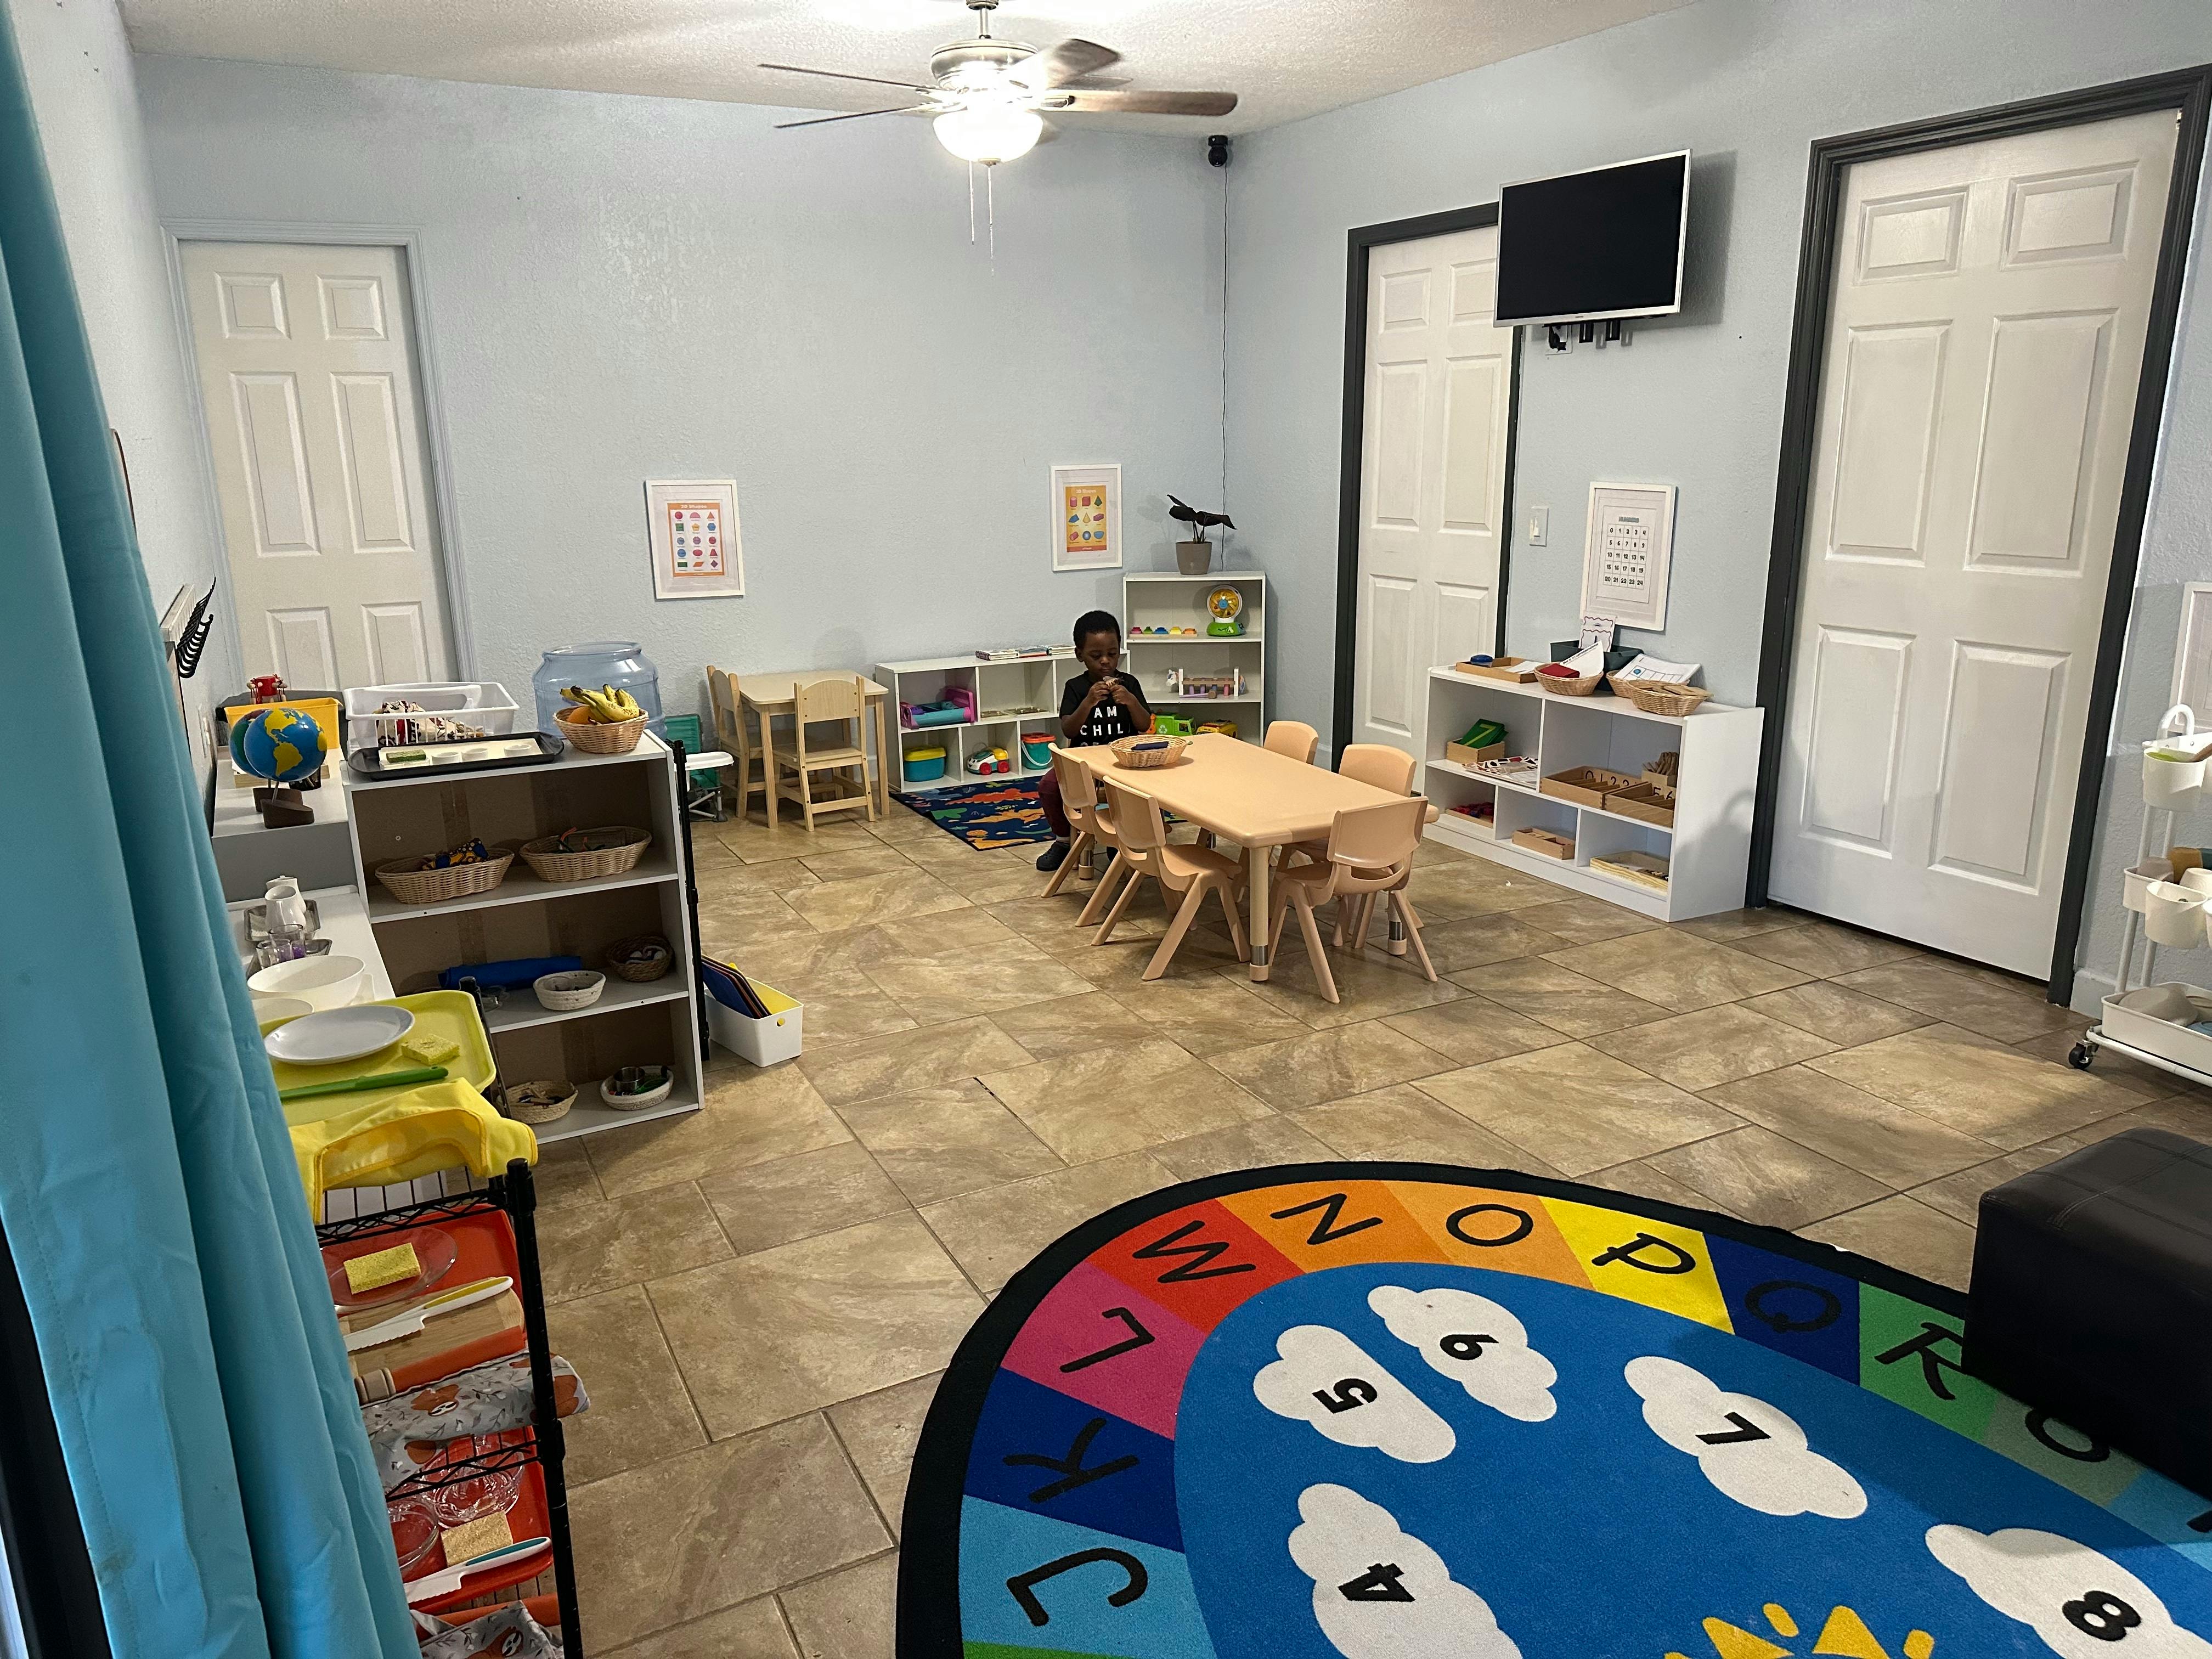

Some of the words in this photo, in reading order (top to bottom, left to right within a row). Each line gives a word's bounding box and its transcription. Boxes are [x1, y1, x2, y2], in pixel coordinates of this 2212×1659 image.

[1080, 723, 1130, 736] CHIL
[1094, 706, 1117, 718] AM
[1464, 724, 1497, 746] 7
[1270, 1193, 1383, 1245] N
[1446, 1203, 1534, 1247] O
[1133, 1220, 1256, 1284] M
[1592, 1232, 1696, 1274] P
[1745, 1280, 1841, 1333] Q
[1060, 1307, 1154, 1373] L
[1440, 1333, 1498, 1360] 6
[1312, 1378, 1378, 1413] 5
[1696, 1412, 1770, 1444] 7
[1003, 1418, 1139, 1503] K
[1007, 1547, 1148, 1626] J
[1338, 1562, 1414, 1602] 4
[2063, 1590, 2141, 1641] 8
